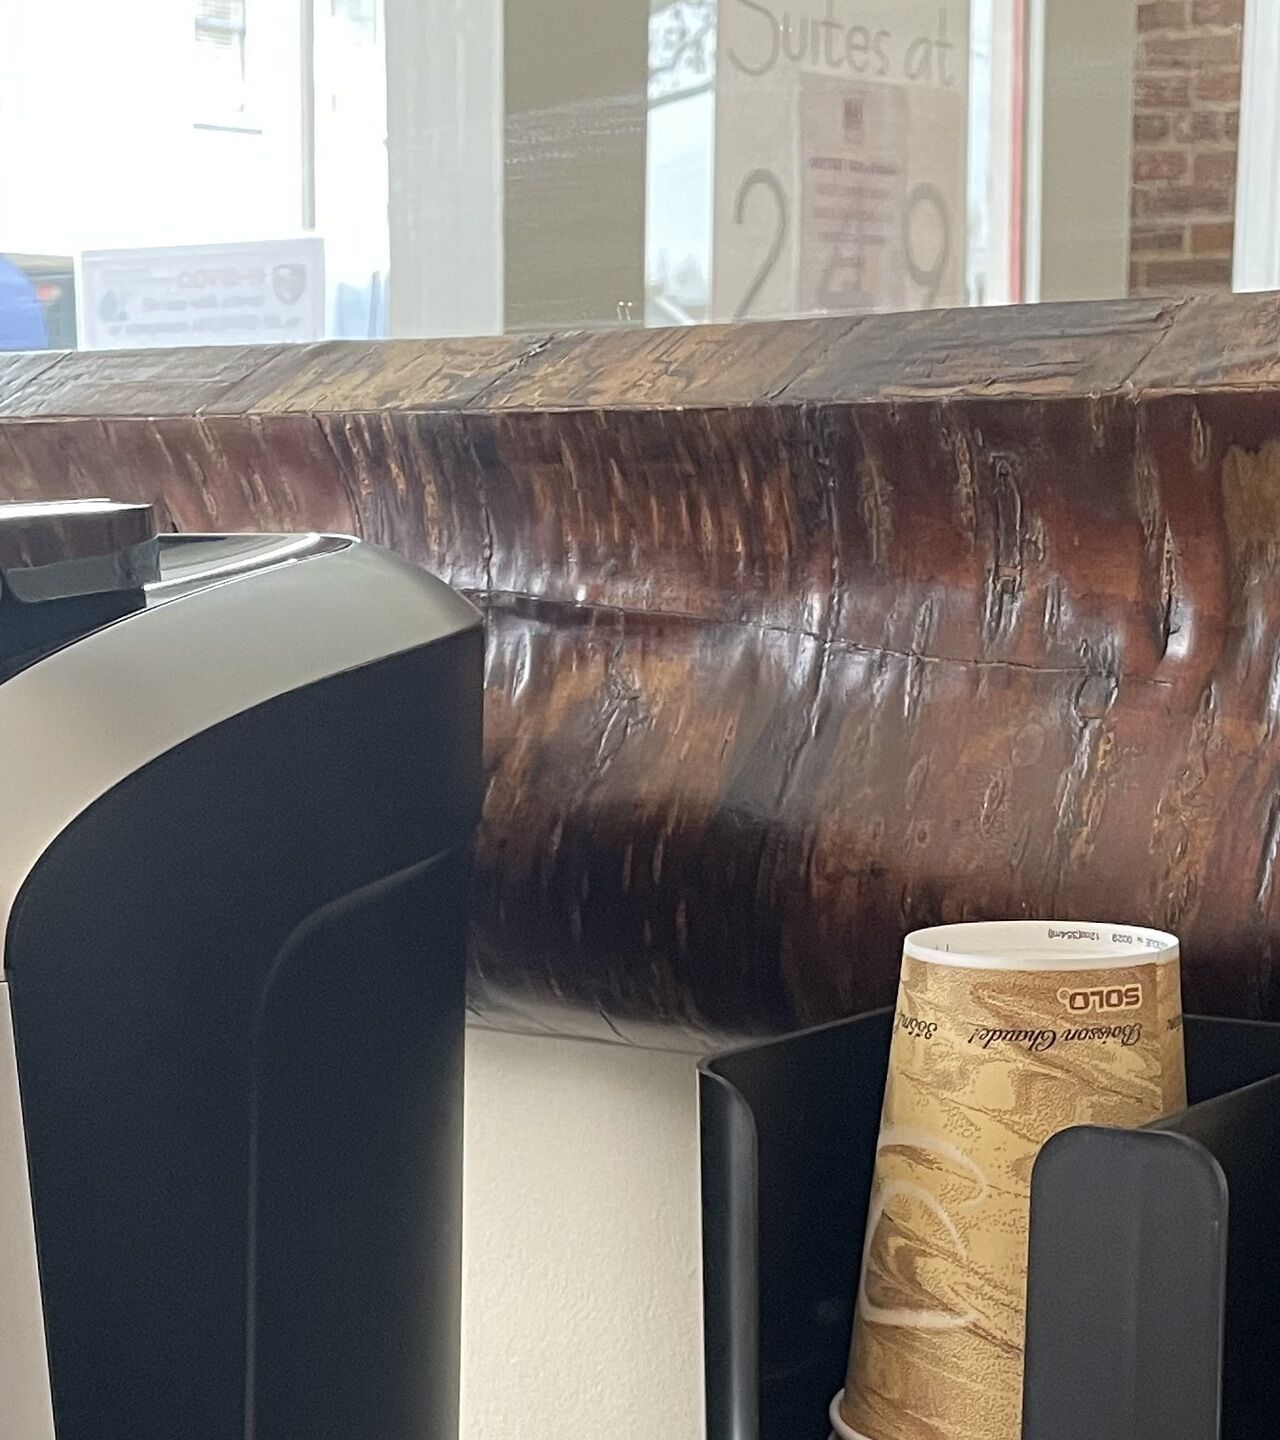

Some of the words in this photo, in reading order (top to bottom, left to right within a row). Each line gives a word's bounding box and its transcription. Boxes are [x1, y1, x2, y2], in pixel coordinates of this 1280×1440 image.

[904, 8, 960, 87] at
[1069, 986, 1140, 1011] SOLO
[967, 1027, 1058, 1053] Chaude!
[1060, 1023, 1143, 1048] Boisson
